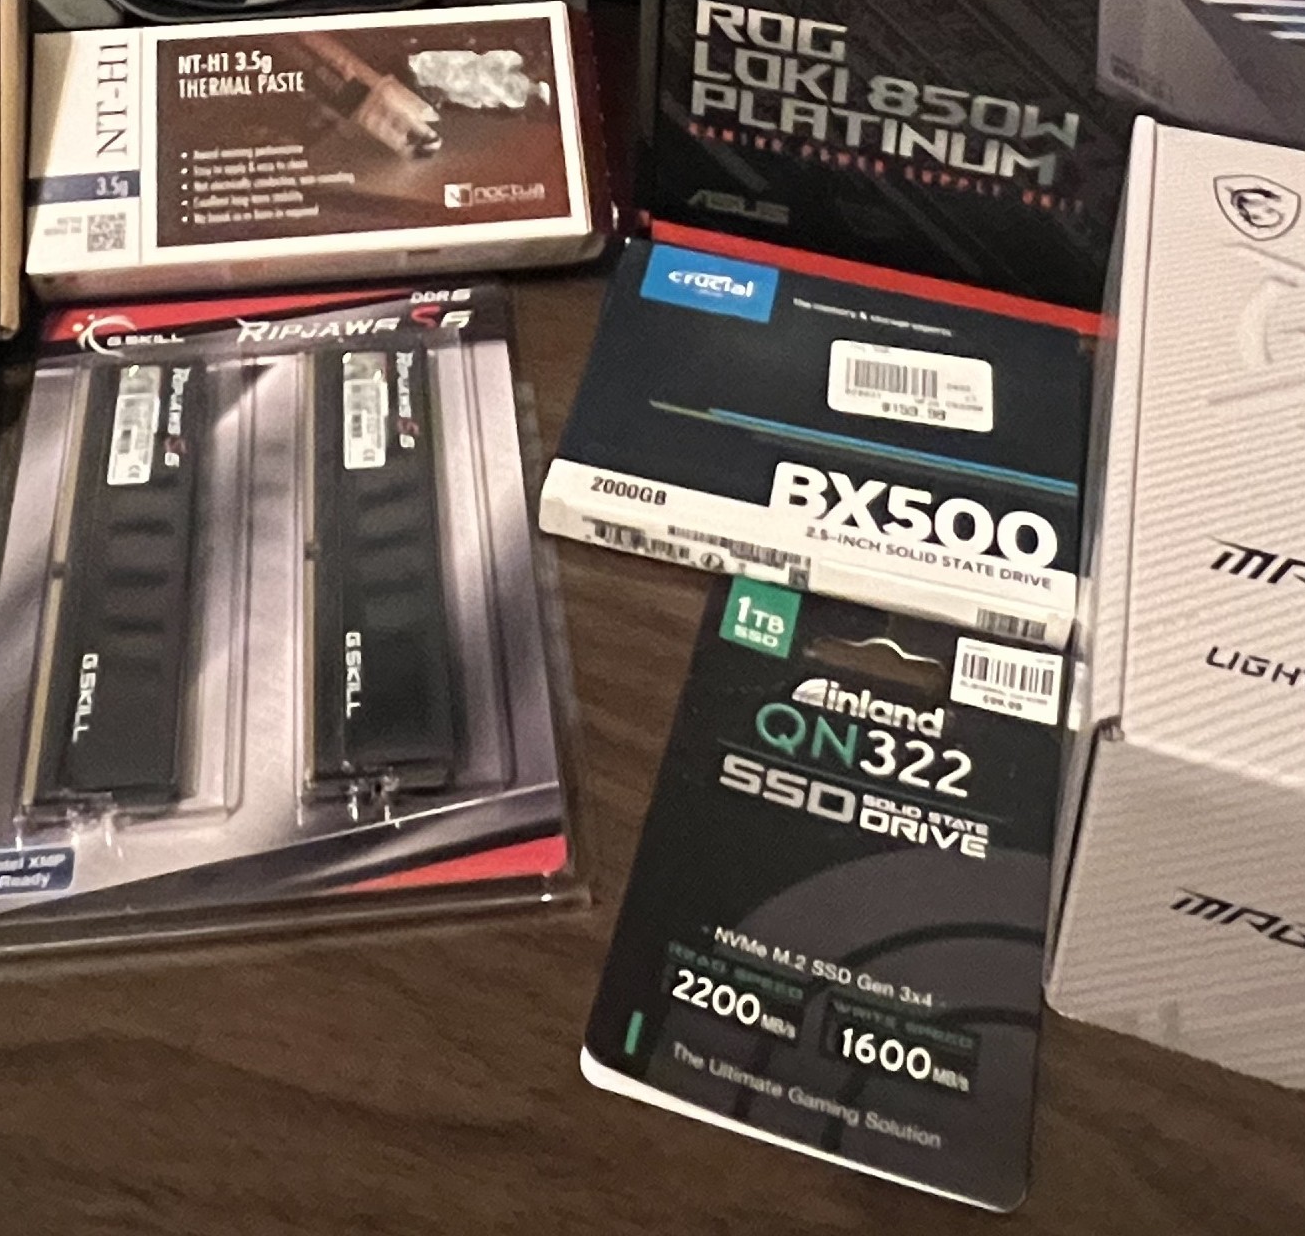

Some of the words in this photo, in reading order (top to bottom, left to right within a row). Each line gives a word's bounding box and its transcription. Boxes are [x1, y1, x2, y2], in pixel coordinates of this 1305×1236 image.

[178, 53, 230, 75] NT-H1
[235, 50, 273, 74] 3.5g
[179, 75, 252, 99] THERMAL
[258, 71, 305, 94] PASTE
[694, 39, 848, 104] LOKI
[867, 76, 1080, 150] 850W
[691, 79, 1058, 186] PLATINUM
[668, 268, 754, 299] crucial
[591, 475, 668, 507] 2000GB
[773, 461, 1058, 569] BX500
[806, 525, 882, 554] 2.5-INCH
[885, 542, 939, 566] SOLID
[942, 554, 996, 578] STATE
[999, 565, 1052, 591] DRIVE
[734, 625, 779, 649] SSD
[826, 680, 946, 738] inland
[719, 754, 855, 824] SSD
[862, 793, 922, 819] SOLID
[928, 810, 990, 837] STATE
[859, 807, 989, 859] DRIVE
[714, 926, 768, 959] NVMe
[771, 947, 806, 972] M.2
[811, 959, 852, 985] SSD
[856, 972, 896, 999] Gen
[899, 985, 934, 1009] 3x4
[672, 969, 761, 1026] 2200
[841, 1027, 932, 1081] 1600
[672, 1042, 706, 1070] The
[708, 1052, 783, 1098] Ultimate
[787, 1086, 861, 1127] Gaming
[864, 1110, 942, 1150] Solution
